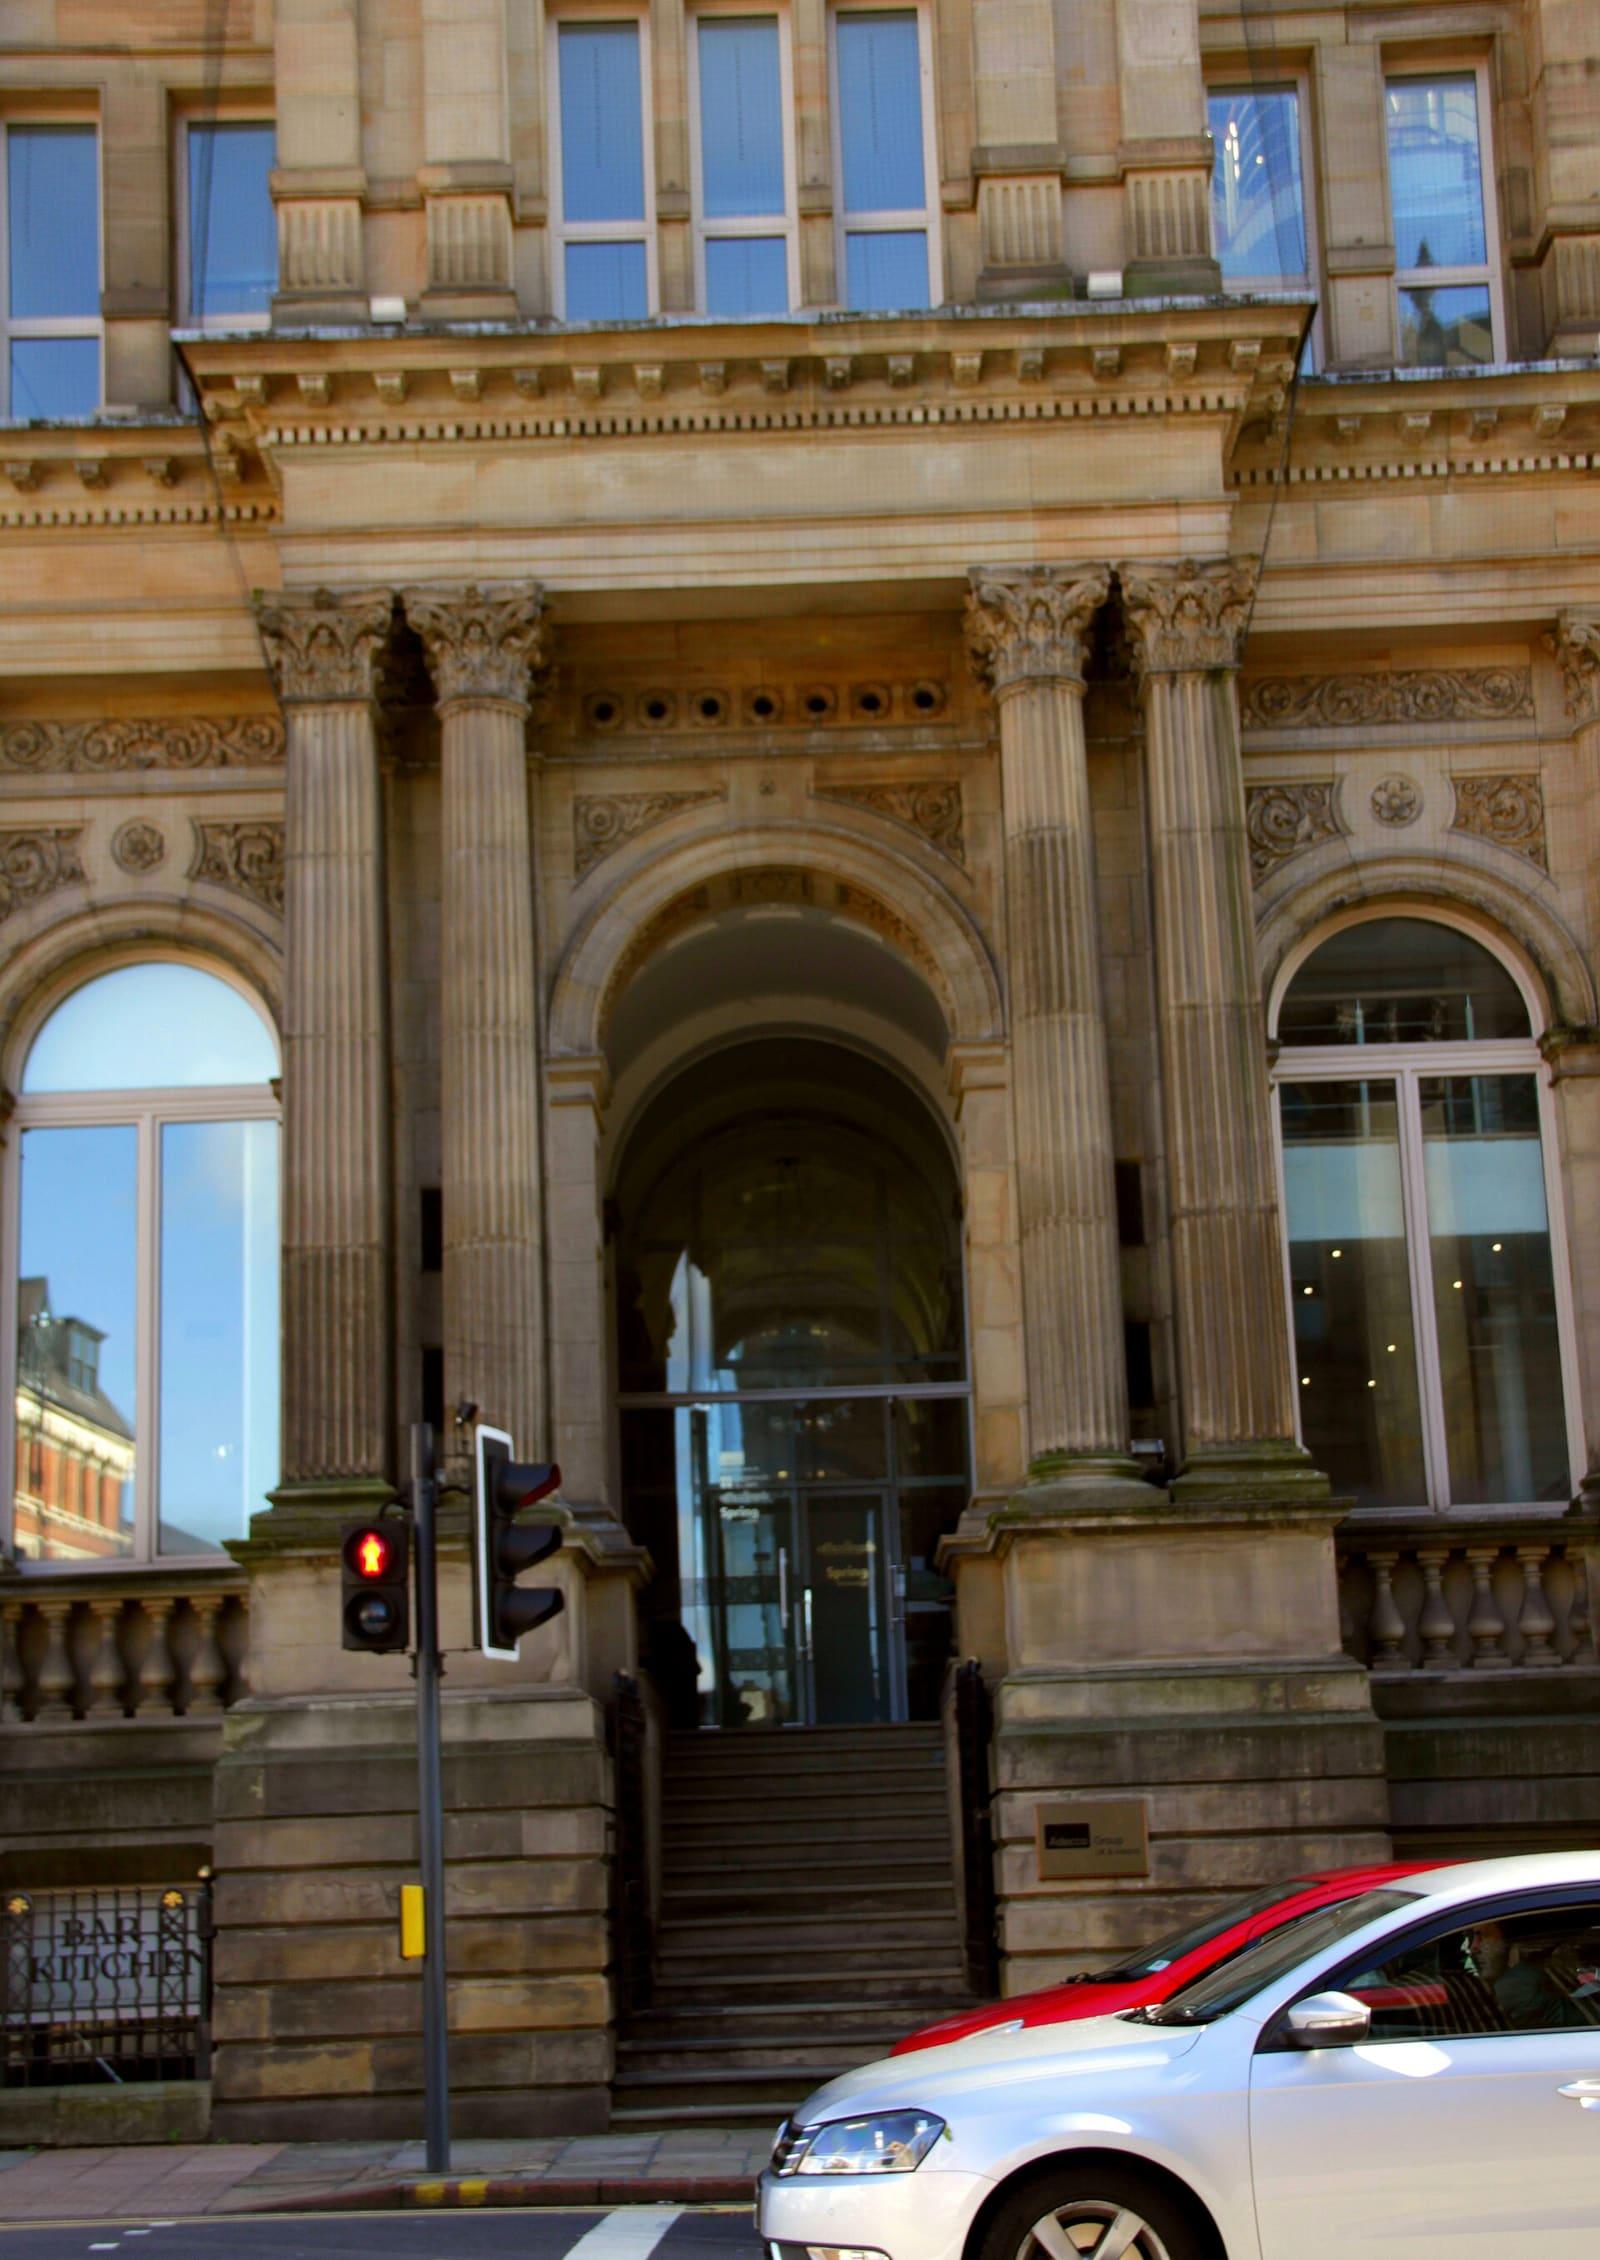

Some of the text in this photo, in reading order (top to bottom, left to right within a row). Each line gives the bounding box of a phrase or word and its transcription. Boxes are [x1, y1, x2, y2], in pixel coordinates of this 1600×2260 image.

[719, 1505, 760, 1522] Spring
[61, 1912, 186, 1946] BAR &
